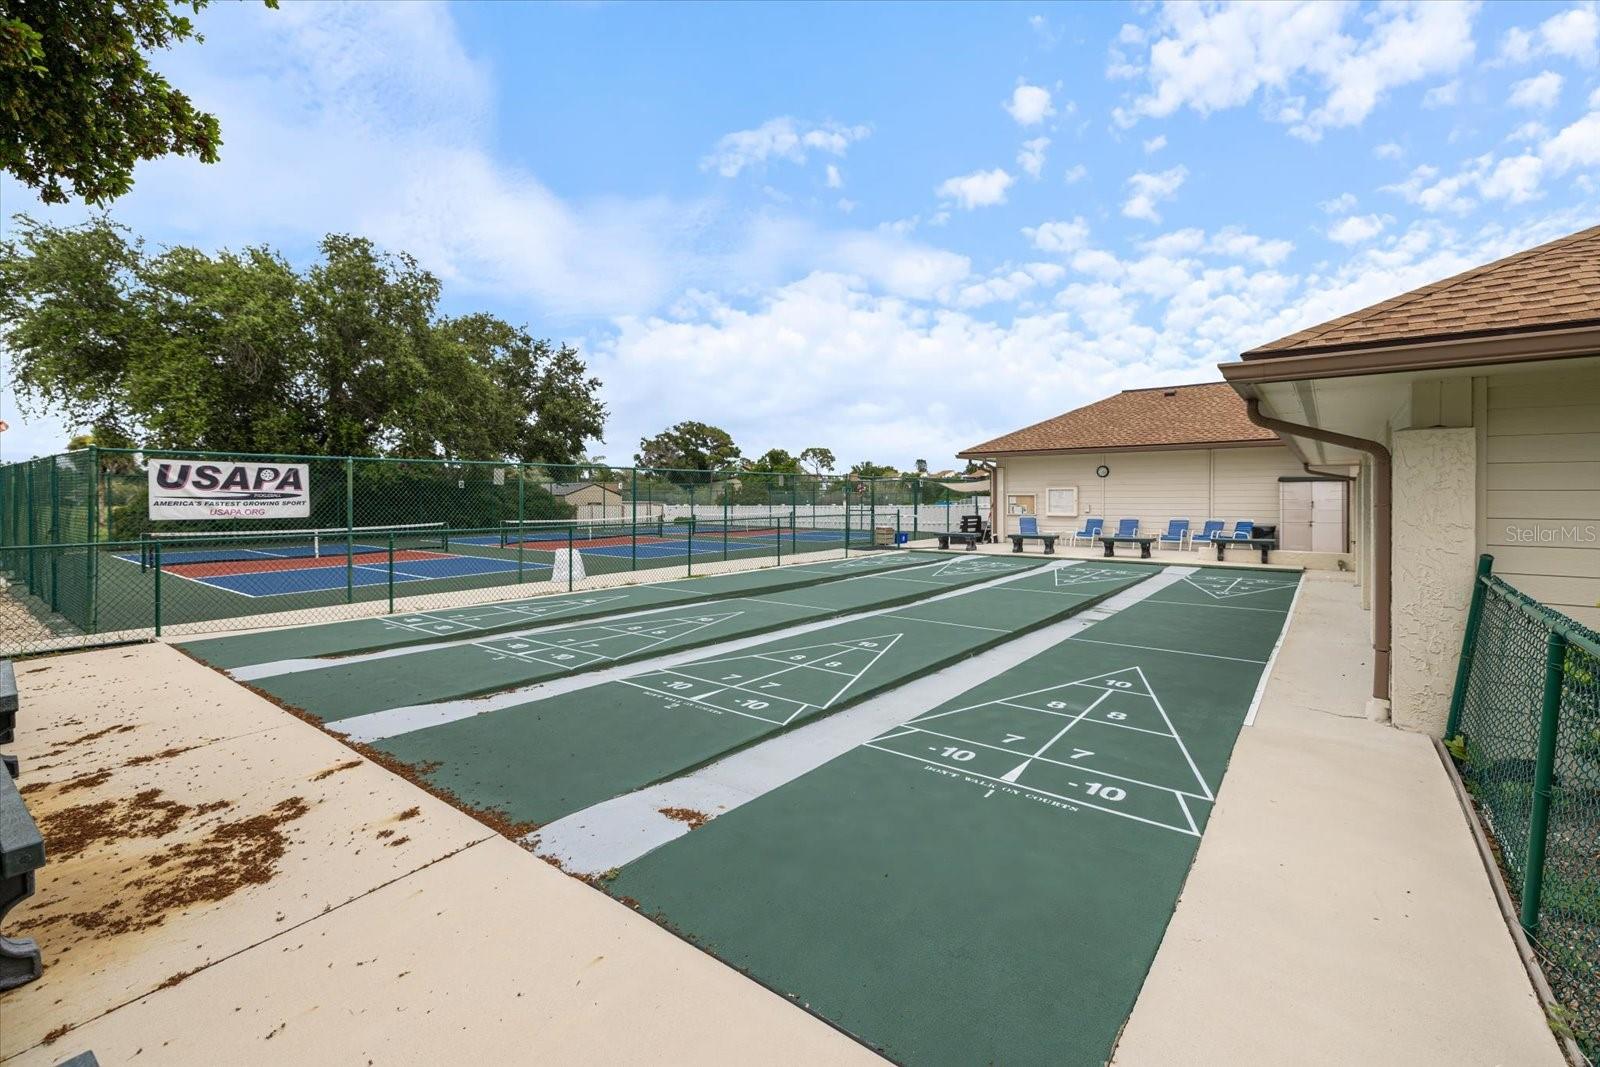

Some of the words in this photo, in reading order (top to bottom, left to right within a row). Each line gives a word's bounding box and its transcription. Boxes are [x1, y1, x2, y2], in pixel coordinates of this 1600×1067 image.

[156, 463, 304, 491] USAPA
[209, 508, 266, 516] USAPA.ORG
[825, 660, 842, 668] 8
[721, 673, 742, 681] 7
[759, 681, 781, 689] 7
[1105, 679, 1132, 688] 10
[735, 698, 770, 711] -10
[1046, 700, 1067, 710] 8
[1106, 710, 1127, 721] 8
[1001, 733, 1027, 744] 7
[927, 745, 977, 762] -10
[1069, 748, 1096, 759] 7
[923, 765, 960, 778] DON'T
[964, 776, 996, 789] WALK
[1002, 786, 1020, 796] ON
[1025, 793, 1079, 812] COURTS
[1068, 781, 1127, 802] -10
